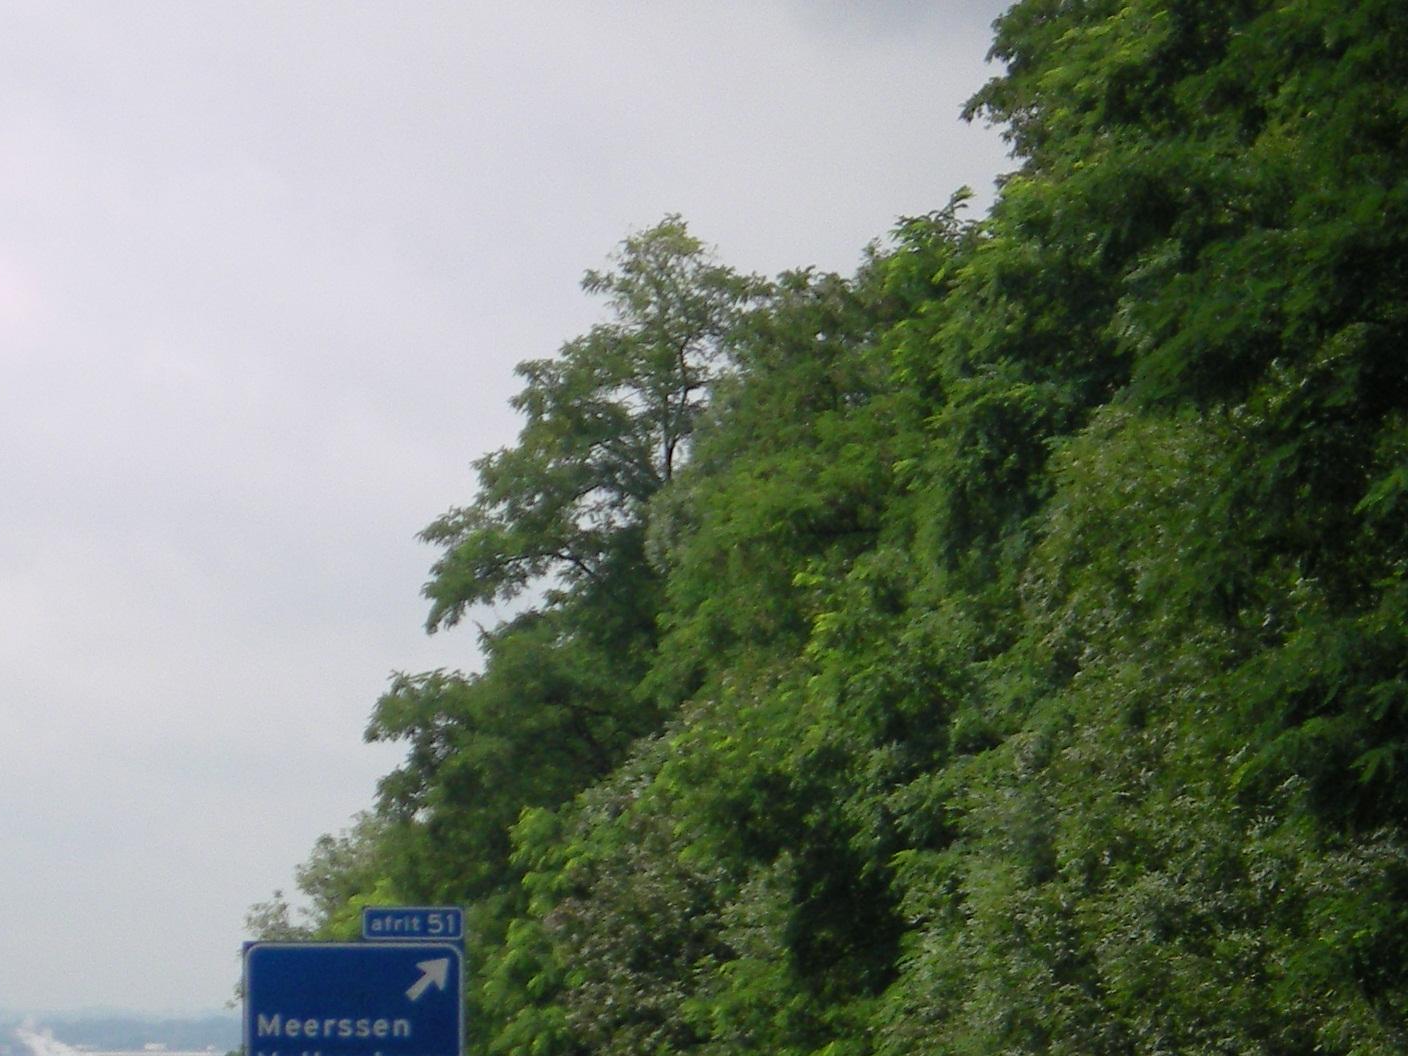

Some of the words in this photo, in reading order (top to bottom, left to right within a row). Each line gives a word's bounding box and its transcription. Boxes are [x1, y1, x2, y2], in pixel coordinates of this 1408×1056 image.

[371, 916, 419, 932] afrit
[427, 913, 455, 933] 51
[257, 1013, 411, 1037] Meerssen
